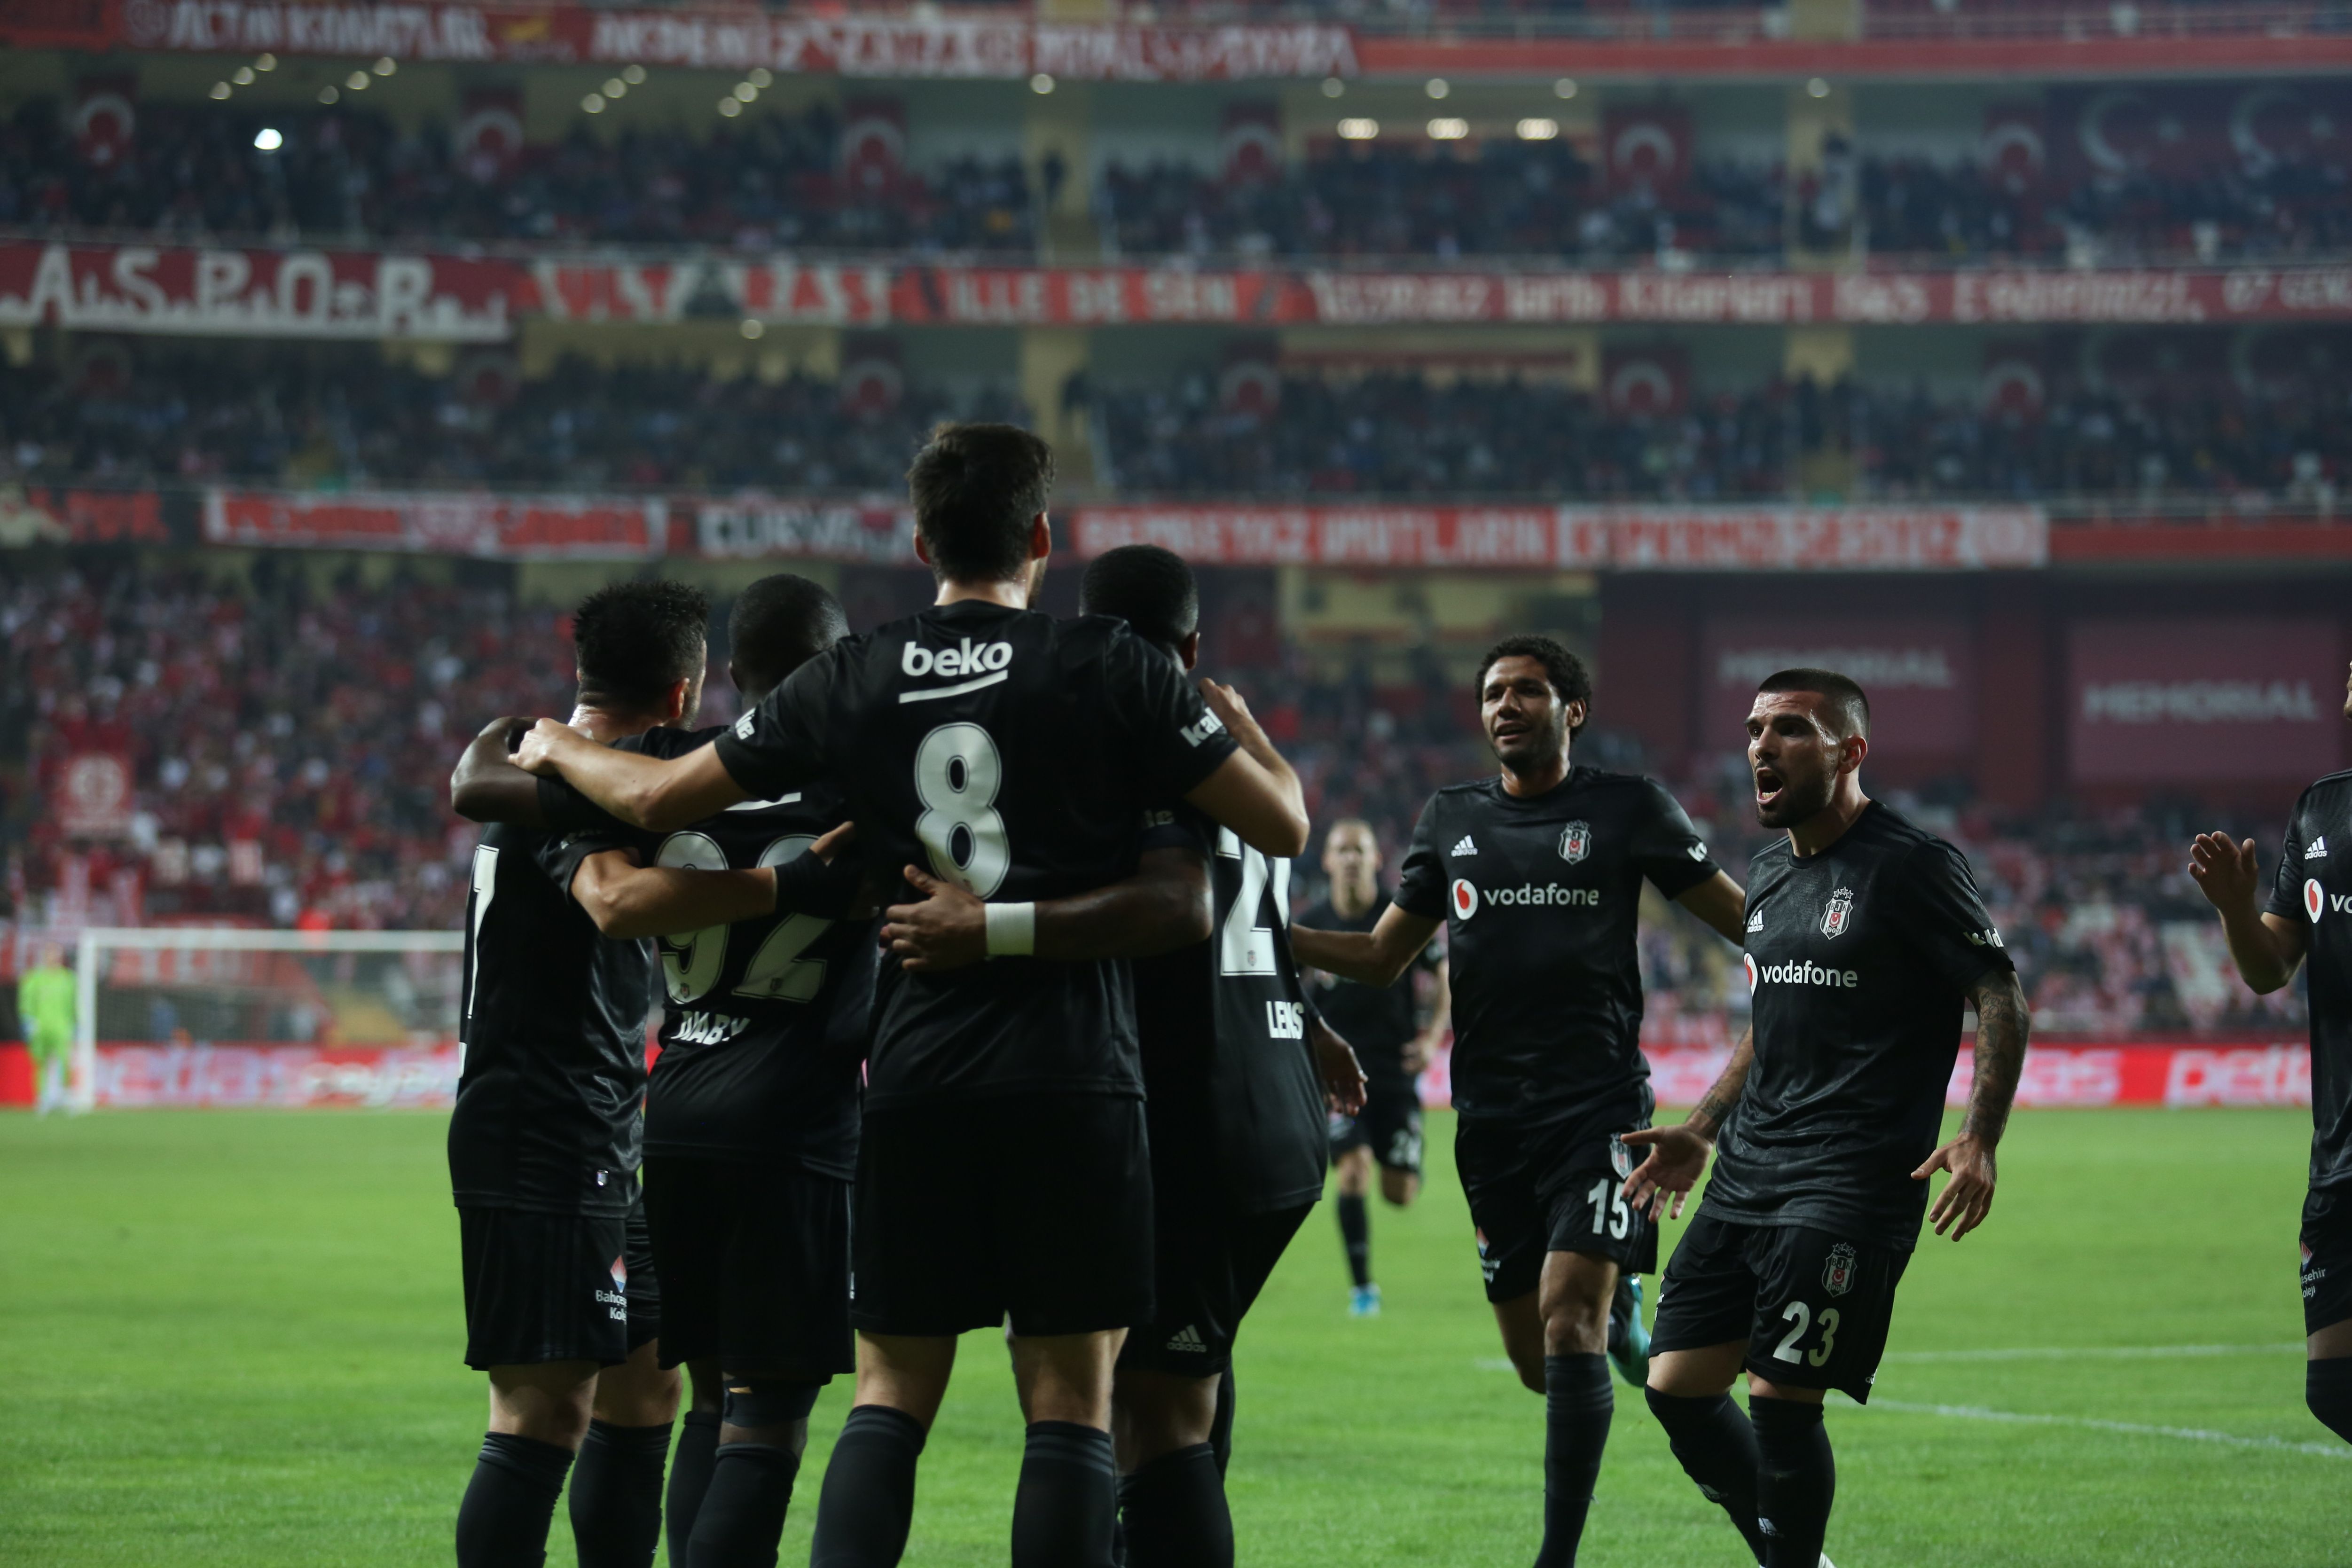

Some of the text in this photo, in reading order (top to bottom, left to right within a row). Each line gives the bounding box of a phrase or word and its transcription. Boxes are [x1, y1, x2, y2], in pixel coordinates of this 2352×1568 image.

[902, 637, 1013, 677] beko
[914, 721, 1011, 902] 8
[2305, 849, 2328, 860] adidas
[1483, 882, 1599, 906] vodafone
[1761, 959, 1858, 988] vodafone
[1587, 1177, 1630, 1240] 15
[1167, 1342, 1207, 1352] adidas
[1772, 1301, 1840, 1367] 23
